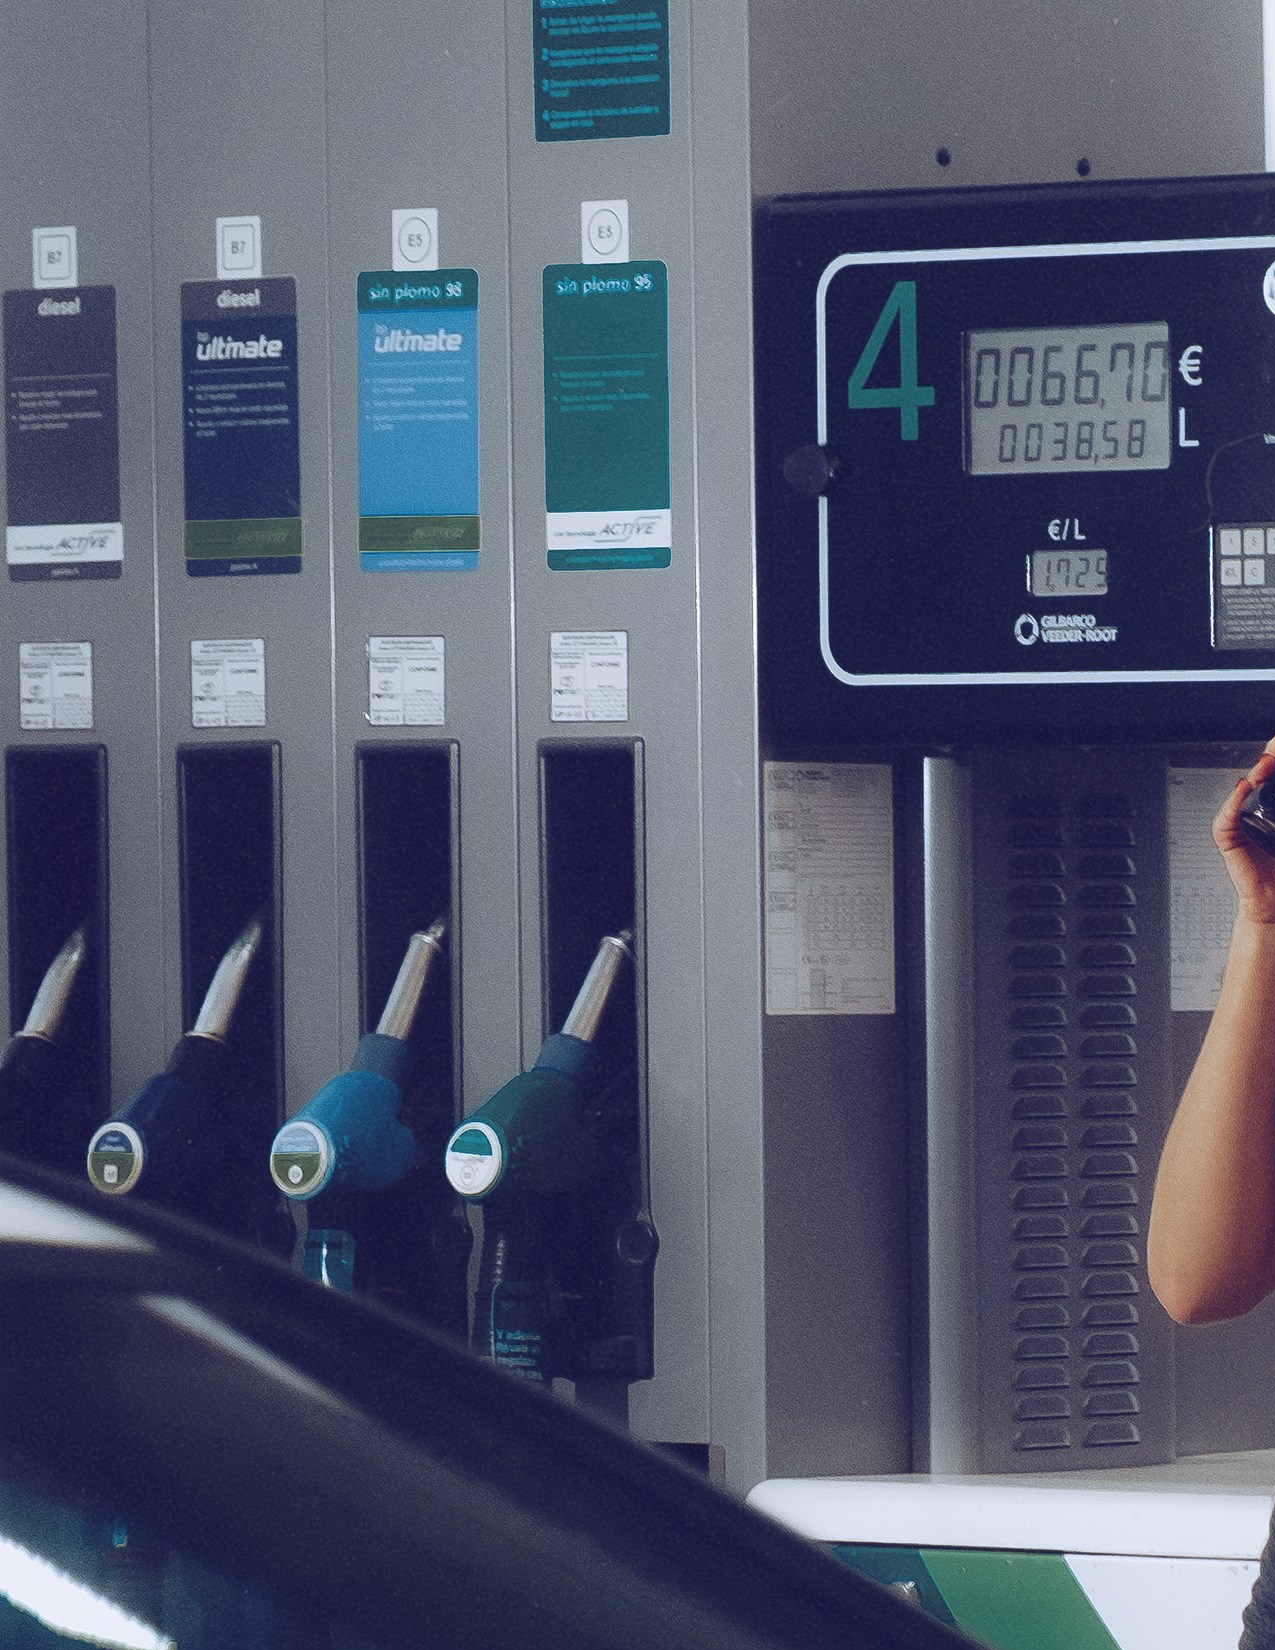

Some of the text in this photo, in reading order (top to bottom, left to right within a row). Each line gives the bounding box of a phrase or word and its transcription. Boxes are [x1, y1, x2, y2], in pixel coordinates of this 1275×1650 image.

[216, 289, 261, 309] diesel
[394, 282, 442, 303] plomo
[37, 296, 82, 317] diesel
[196, 334, 284, 361] ultimate
[374, 327, 463, 354] ultimate
[848, 280, 936, 441] 4
[1178, 345, 1203, 386] €
[1179, 407, 1200, 447] L
